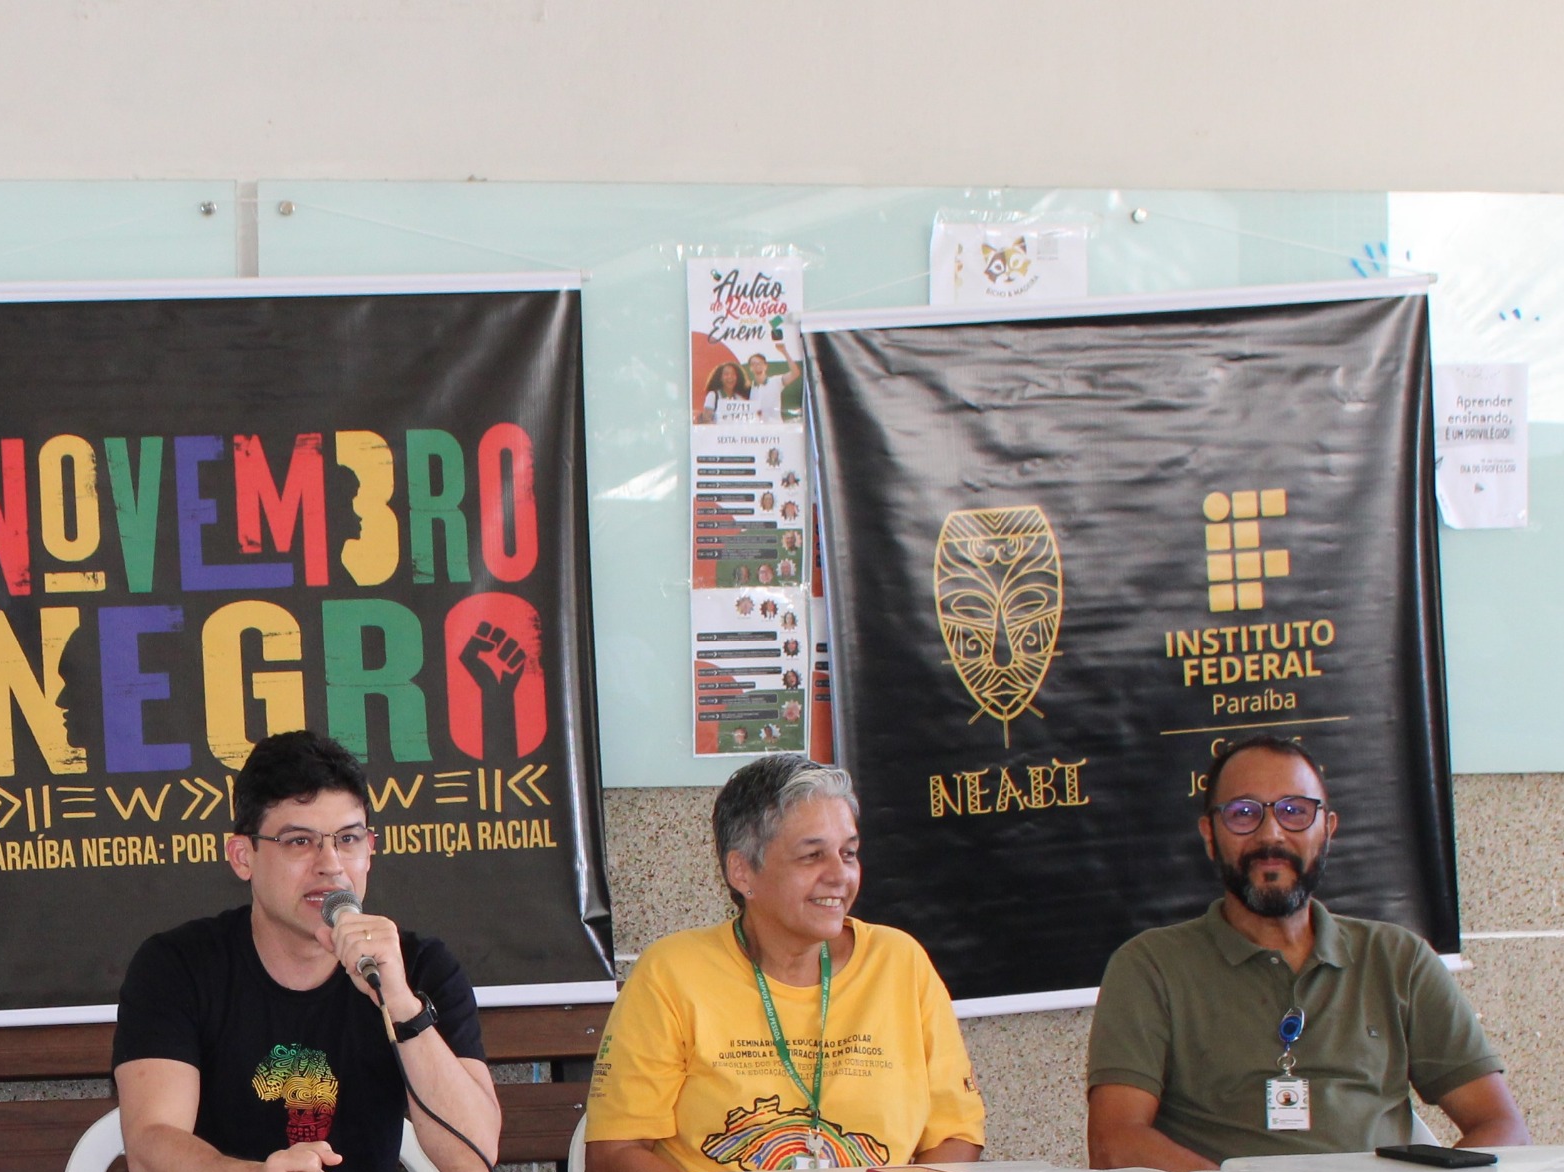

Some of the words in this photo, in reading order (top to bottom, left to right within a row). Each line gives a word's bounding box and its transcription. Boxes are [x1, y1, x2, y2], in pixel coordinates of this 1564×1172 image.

[712, 269, 784, 300] Aulão
[724, 296, 788, 319] Revisão
[707, 314, 766, 344] Enem
[726, 403, 751, 411] 07/11
[1456, 396, 1513, 412] Aprender
[1448, 411, 1513, 425] ensinando,
[740, 436, 759, 444] FEIRA
[761, 436, 780, 444] 07/11
[1164, 619, 1335, 658] INSTITUTO
[1183, 650, 1323, 687] FEDERAL
[1212, 688, 1297, 715] Paraíba
[929, 757, 1091, 818] NEABI
[82, 835, 166, 868] NEGRA:
[172, 833, 218, 864] POR
[382, 822, 472, 858] JUSTIÇA
[477, 818, 558, 850] RACIAL
[756, 973, 769, 1000] CAMPUS
[763, 999, 774, 1017] JOÃO
[769, 1017, 781, 1041] PESSOA
[837, 1034, 872, 1047] ESCOLAR
[718, 1050, 767, 1060] QUILOMBOLA
[832, 1049, 844, 1058] EM
